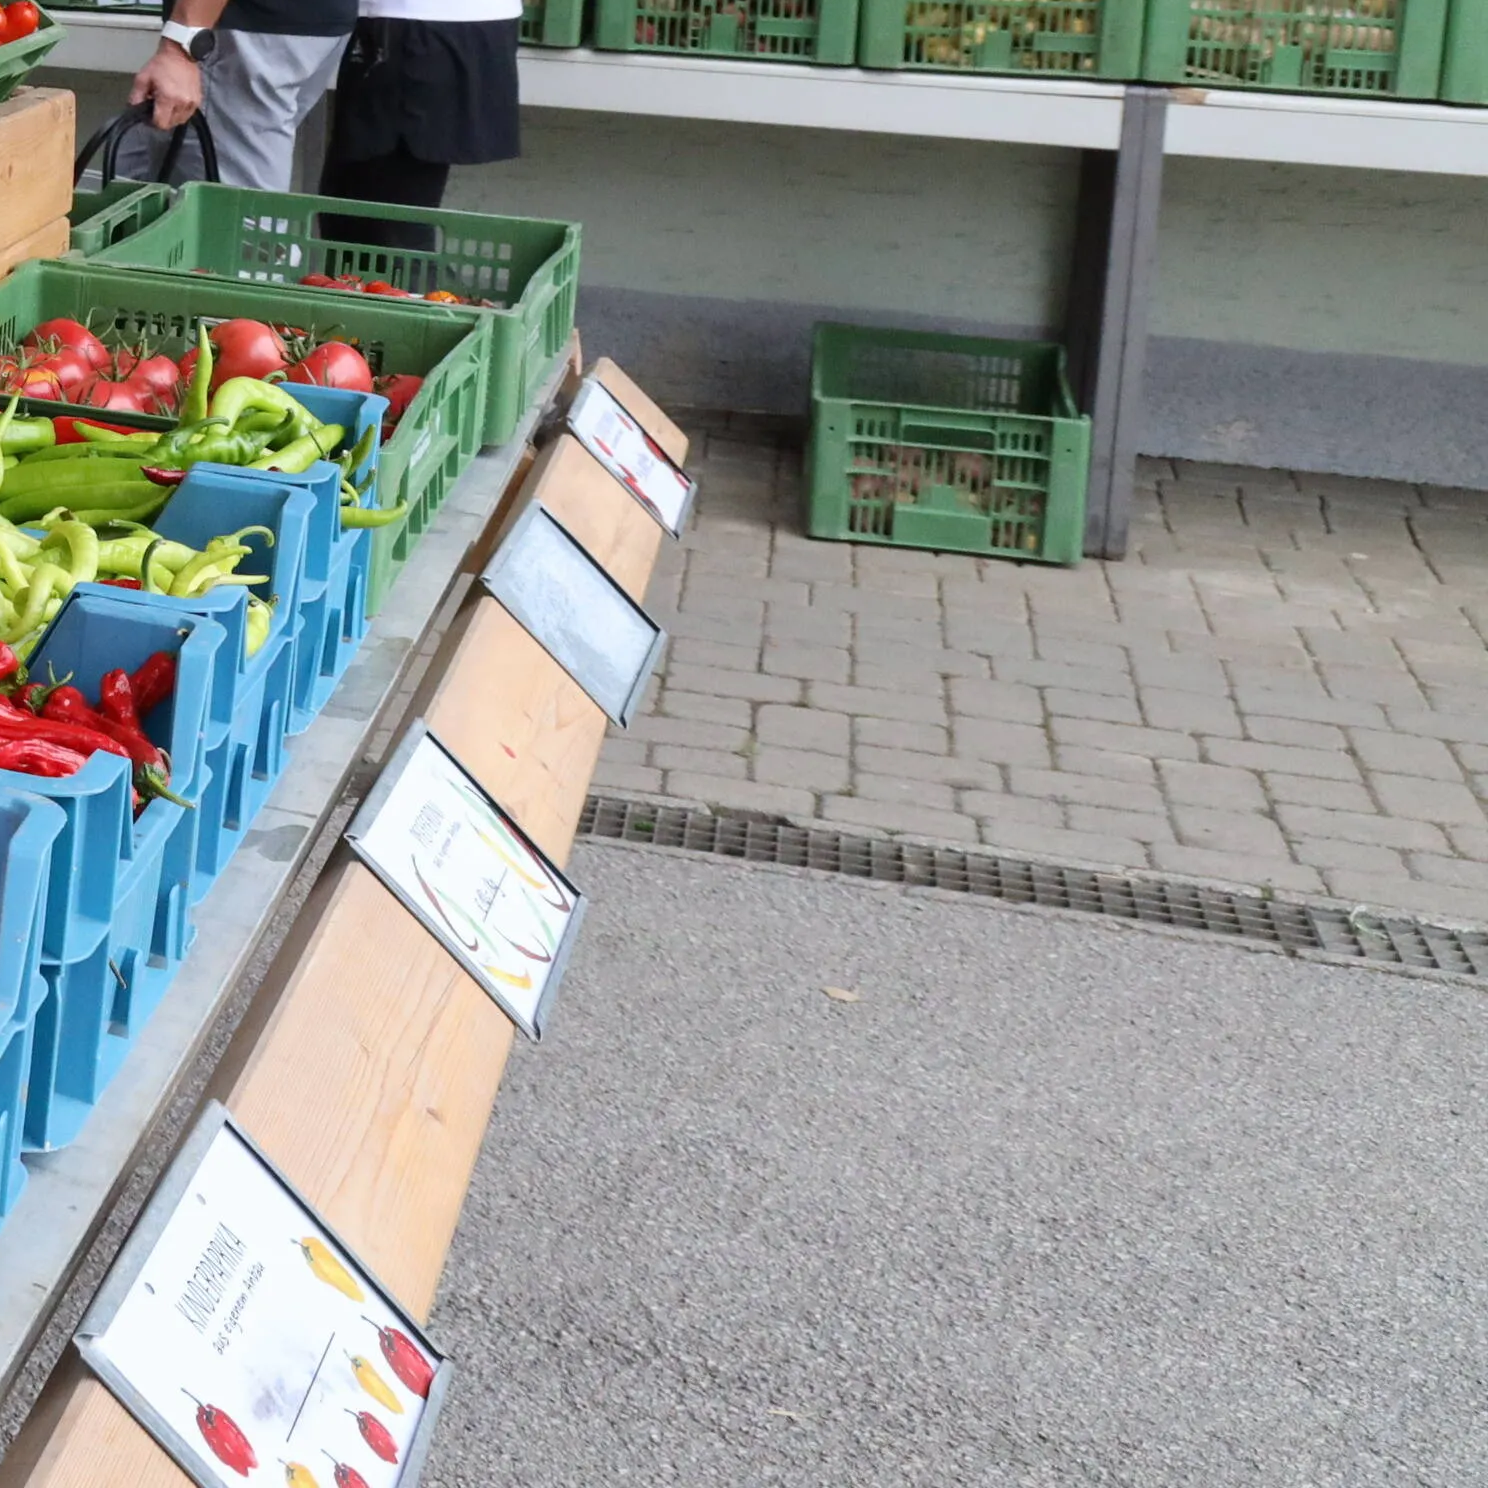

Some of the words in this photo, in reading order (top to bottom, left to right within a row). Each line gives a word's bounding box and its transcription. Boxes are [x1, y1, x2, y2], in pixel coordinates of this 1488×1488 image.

[174, 1220, 249, 1335] KINDERPAPRIKA
[212, 1331, 231, 1356] aus
[223, 1292, 249, 1335] eigenem
